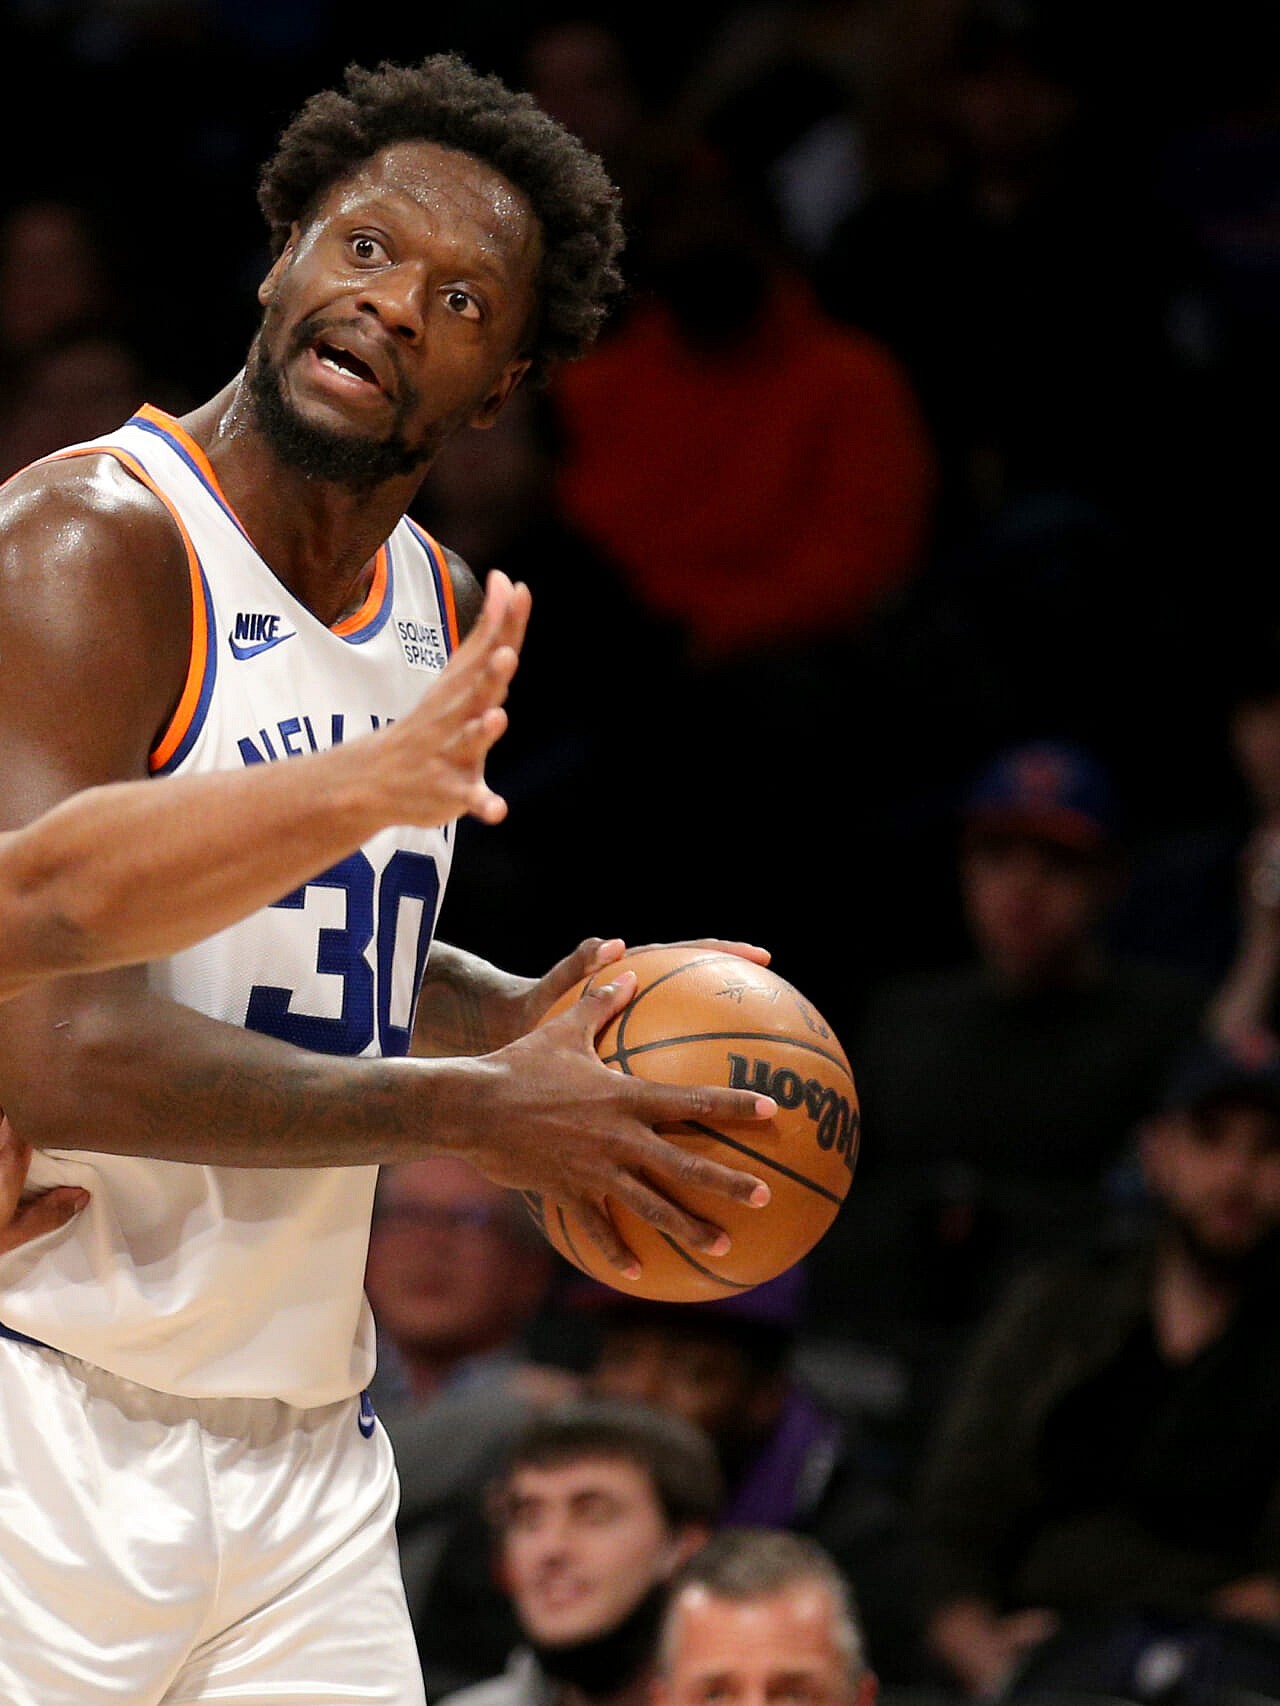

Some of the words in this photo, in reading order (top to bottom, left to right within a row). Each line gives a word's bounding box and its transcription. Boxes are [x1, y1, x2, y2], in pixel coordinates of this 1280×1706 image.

[235, 612, 281, 642] NIKE
[398, 621, 440, 647] SQUARE
[404, 644, 440, 669] SPACE
[245, 849, 440, 1057] 30
